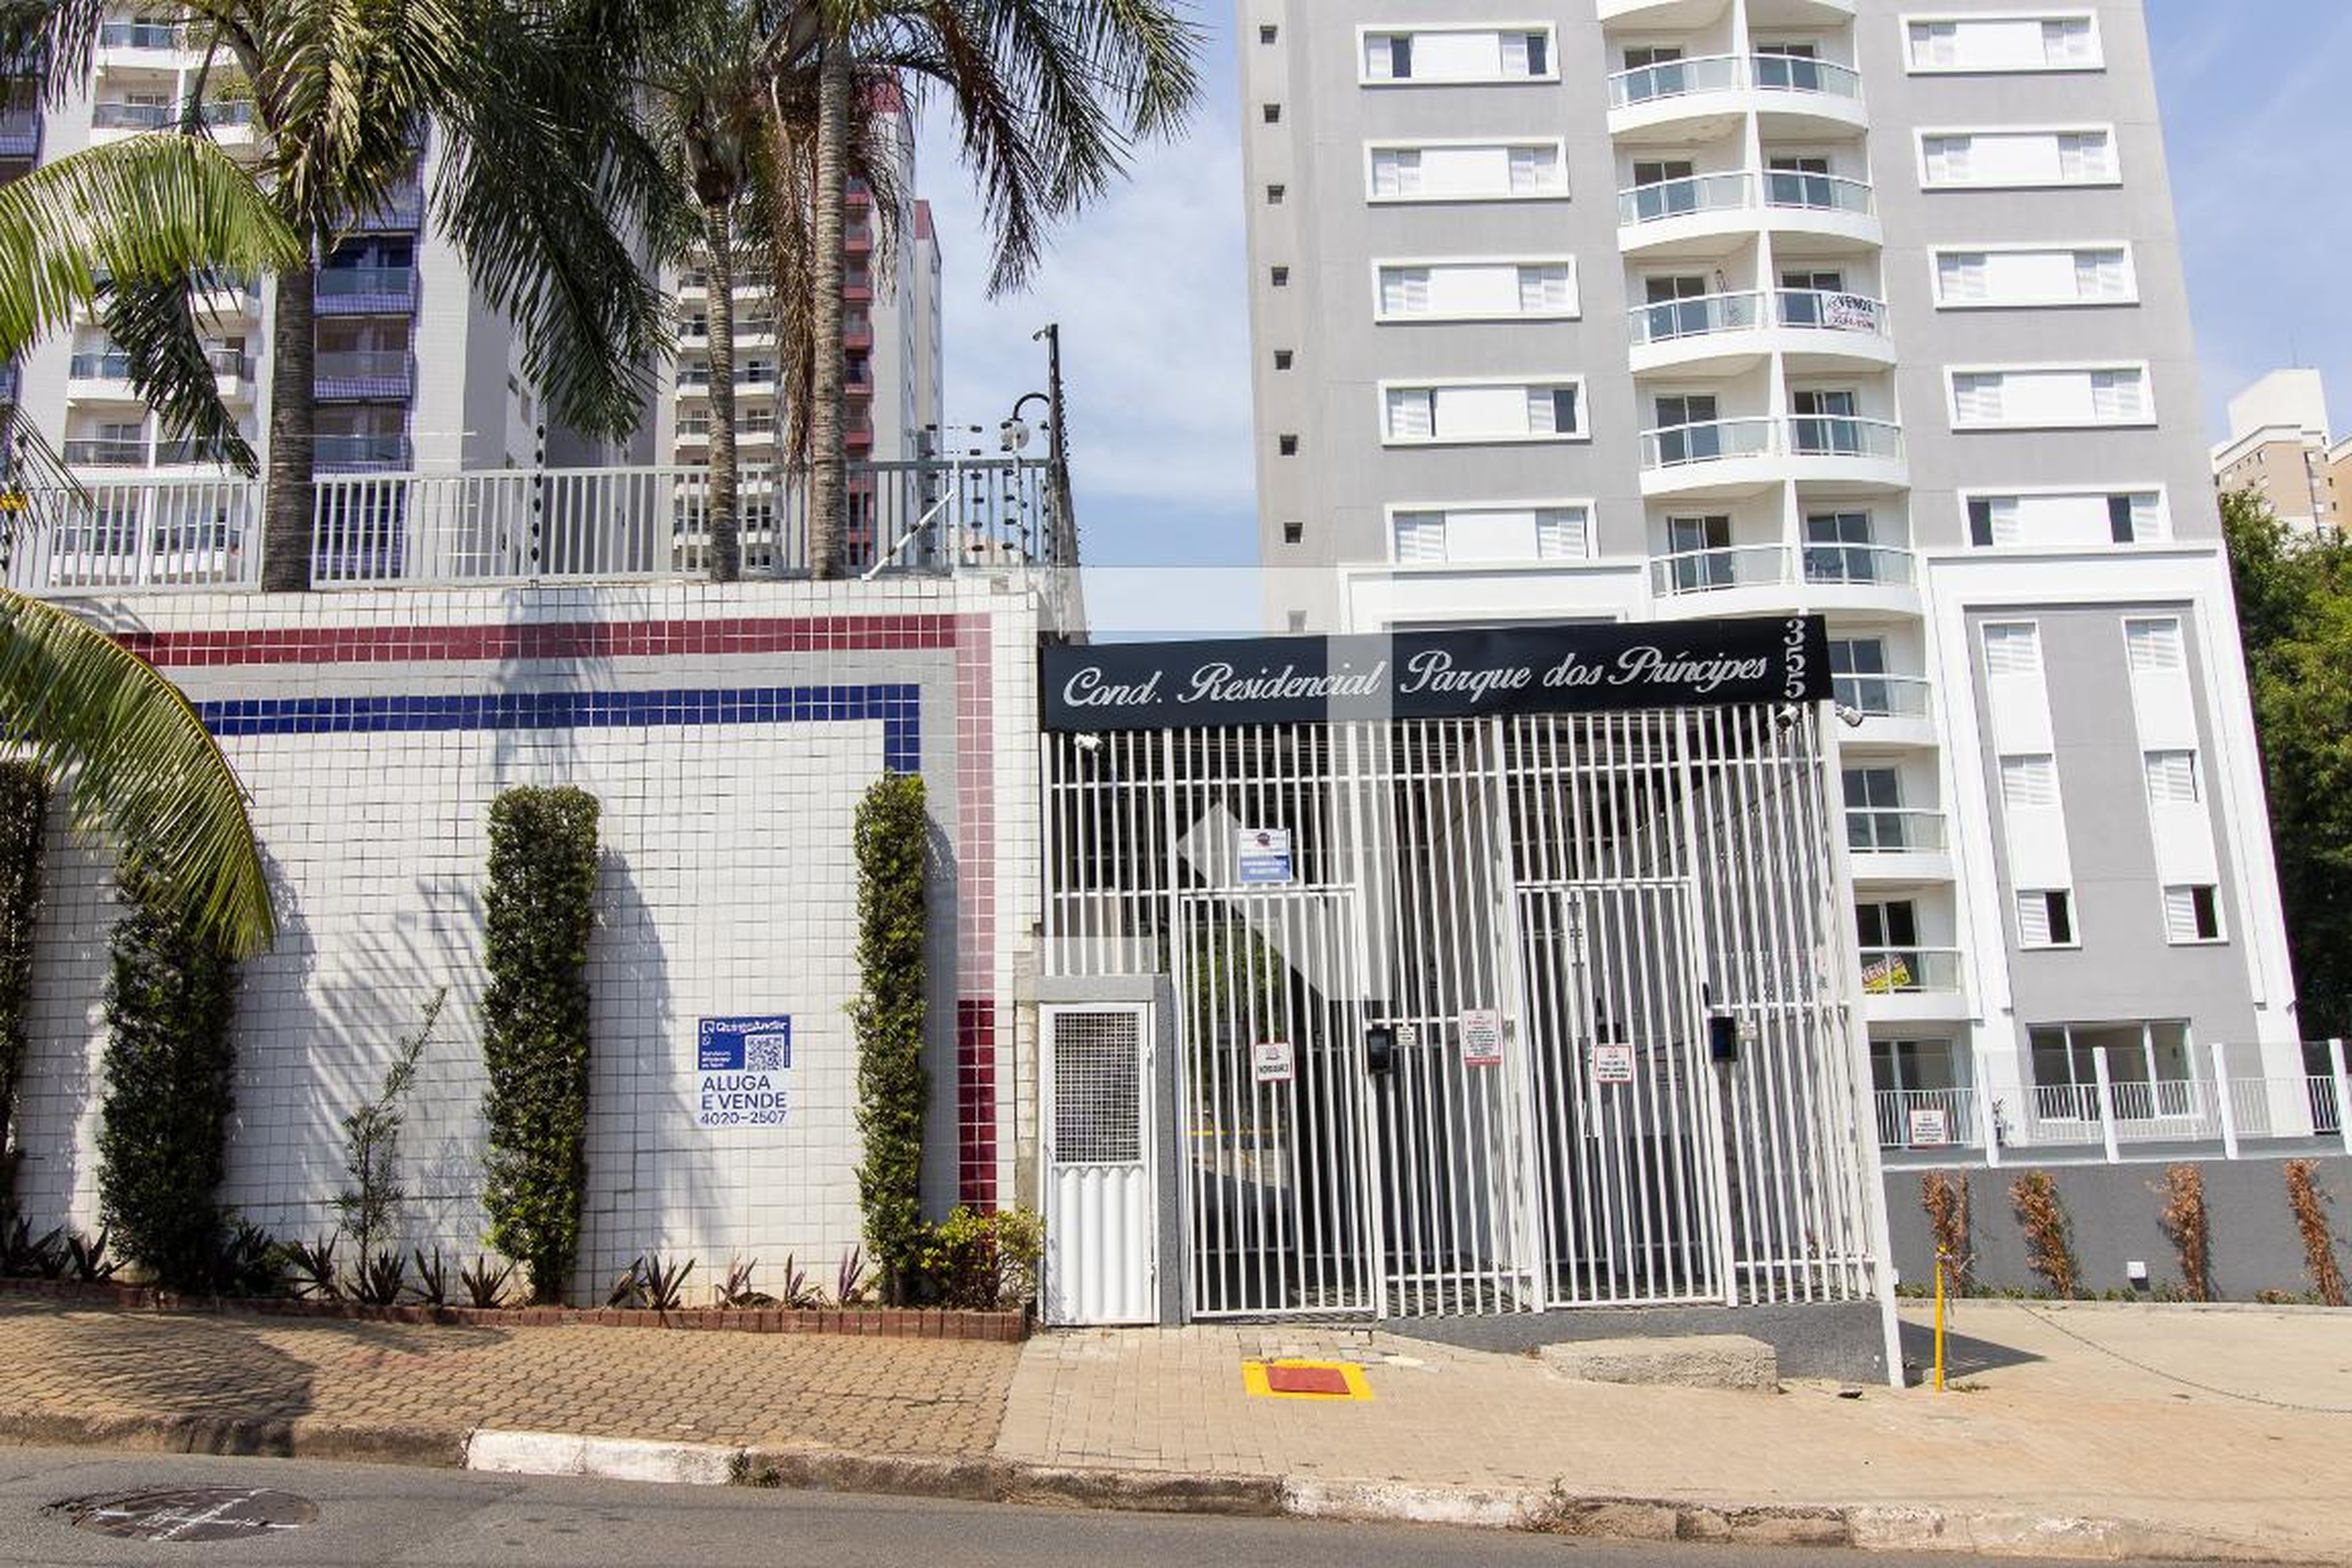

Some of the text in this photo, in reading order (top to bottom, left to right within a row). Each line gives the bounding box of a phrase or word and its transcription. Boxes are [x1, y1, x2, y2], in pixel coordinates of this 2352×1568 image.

[1783, 618, 1807, 698] 355
[1061, 645, 1768, 707] Cond. Residencial Parque dos Príncipes
[702, 1075, 771, 1092] ALUGA
[702, 1092, 786, 1110] E VENDE
[701, 1110, 786, 1125] 4020-2507
